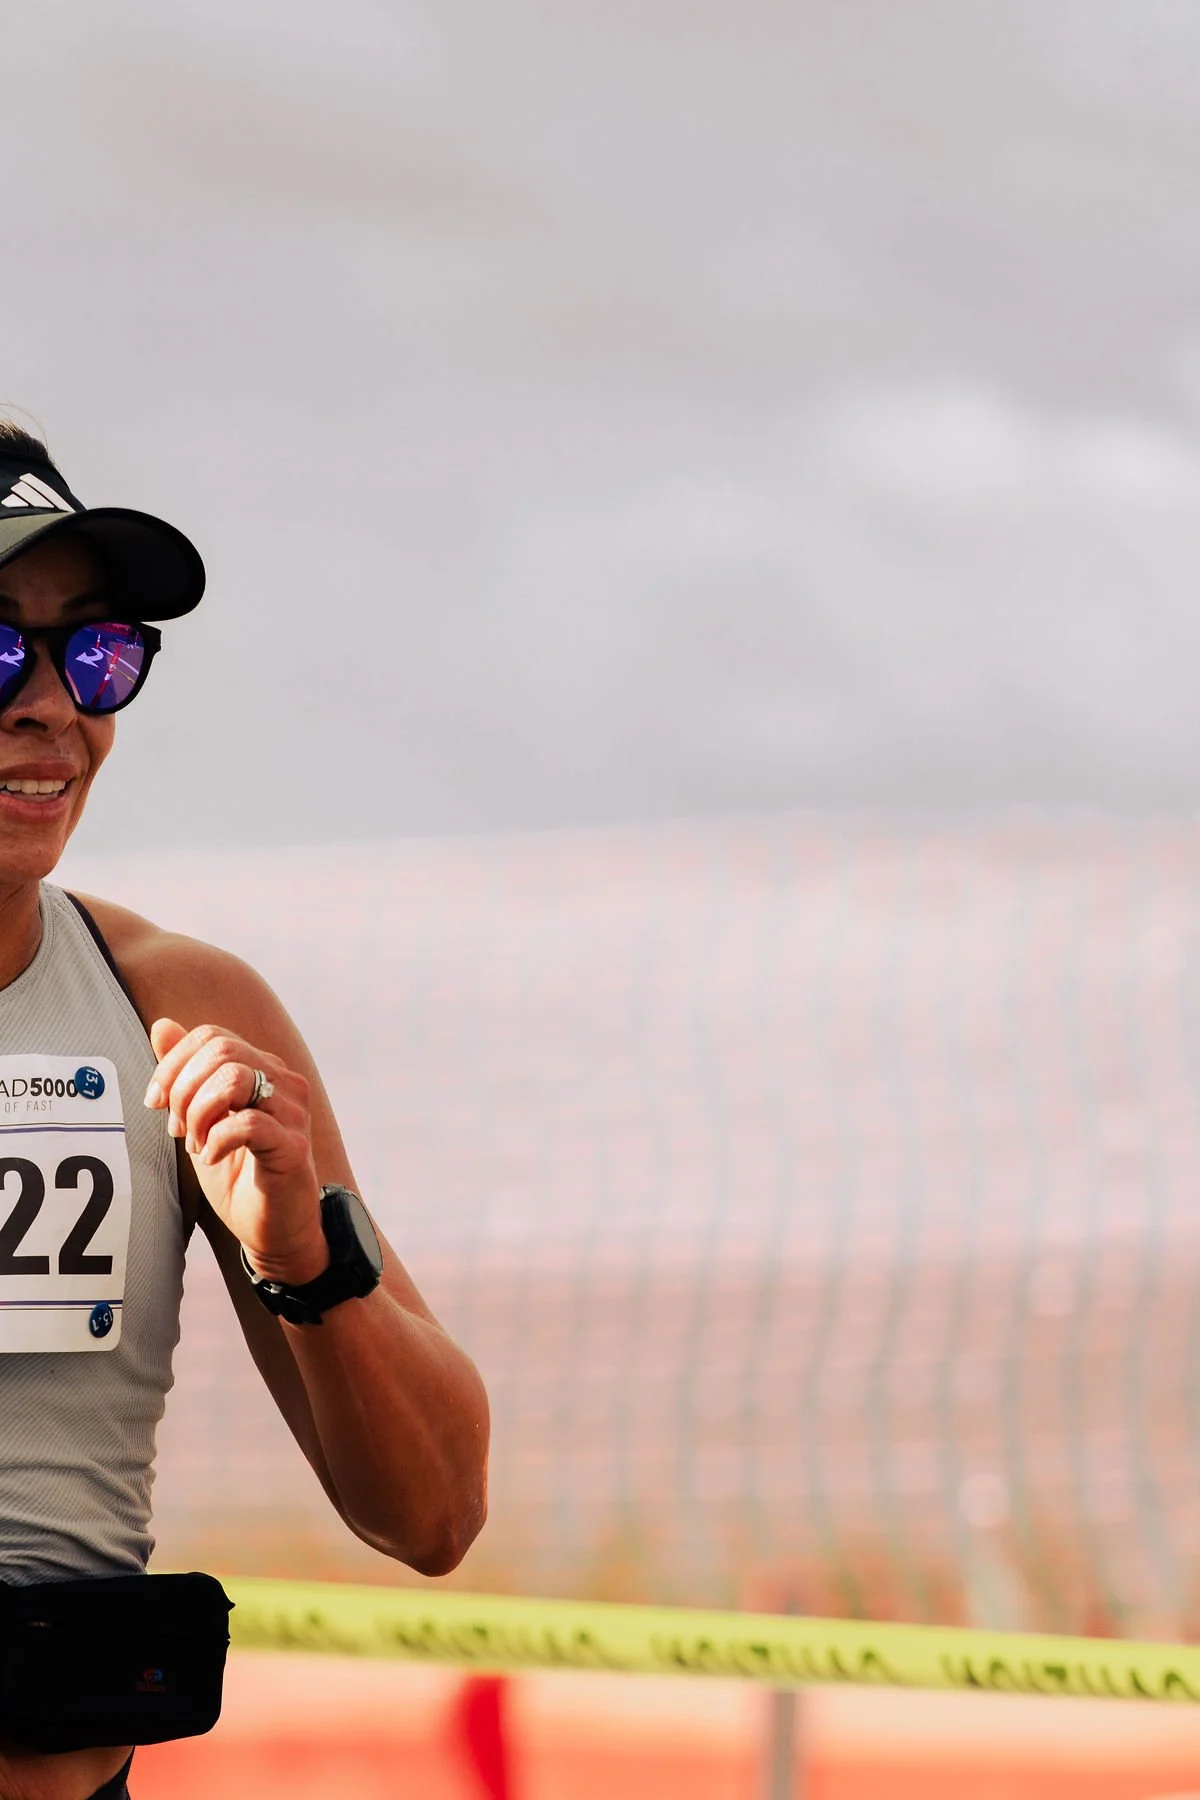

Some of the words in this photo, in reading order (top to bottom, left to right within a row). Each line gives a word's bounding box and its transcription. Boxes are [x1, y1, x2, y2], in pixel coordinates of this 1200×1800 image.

[83, 1068, 99, 1098] 13.1
[4, 1101, 19, 1114] OF
[26, 1100, 55, 1113] FAST
